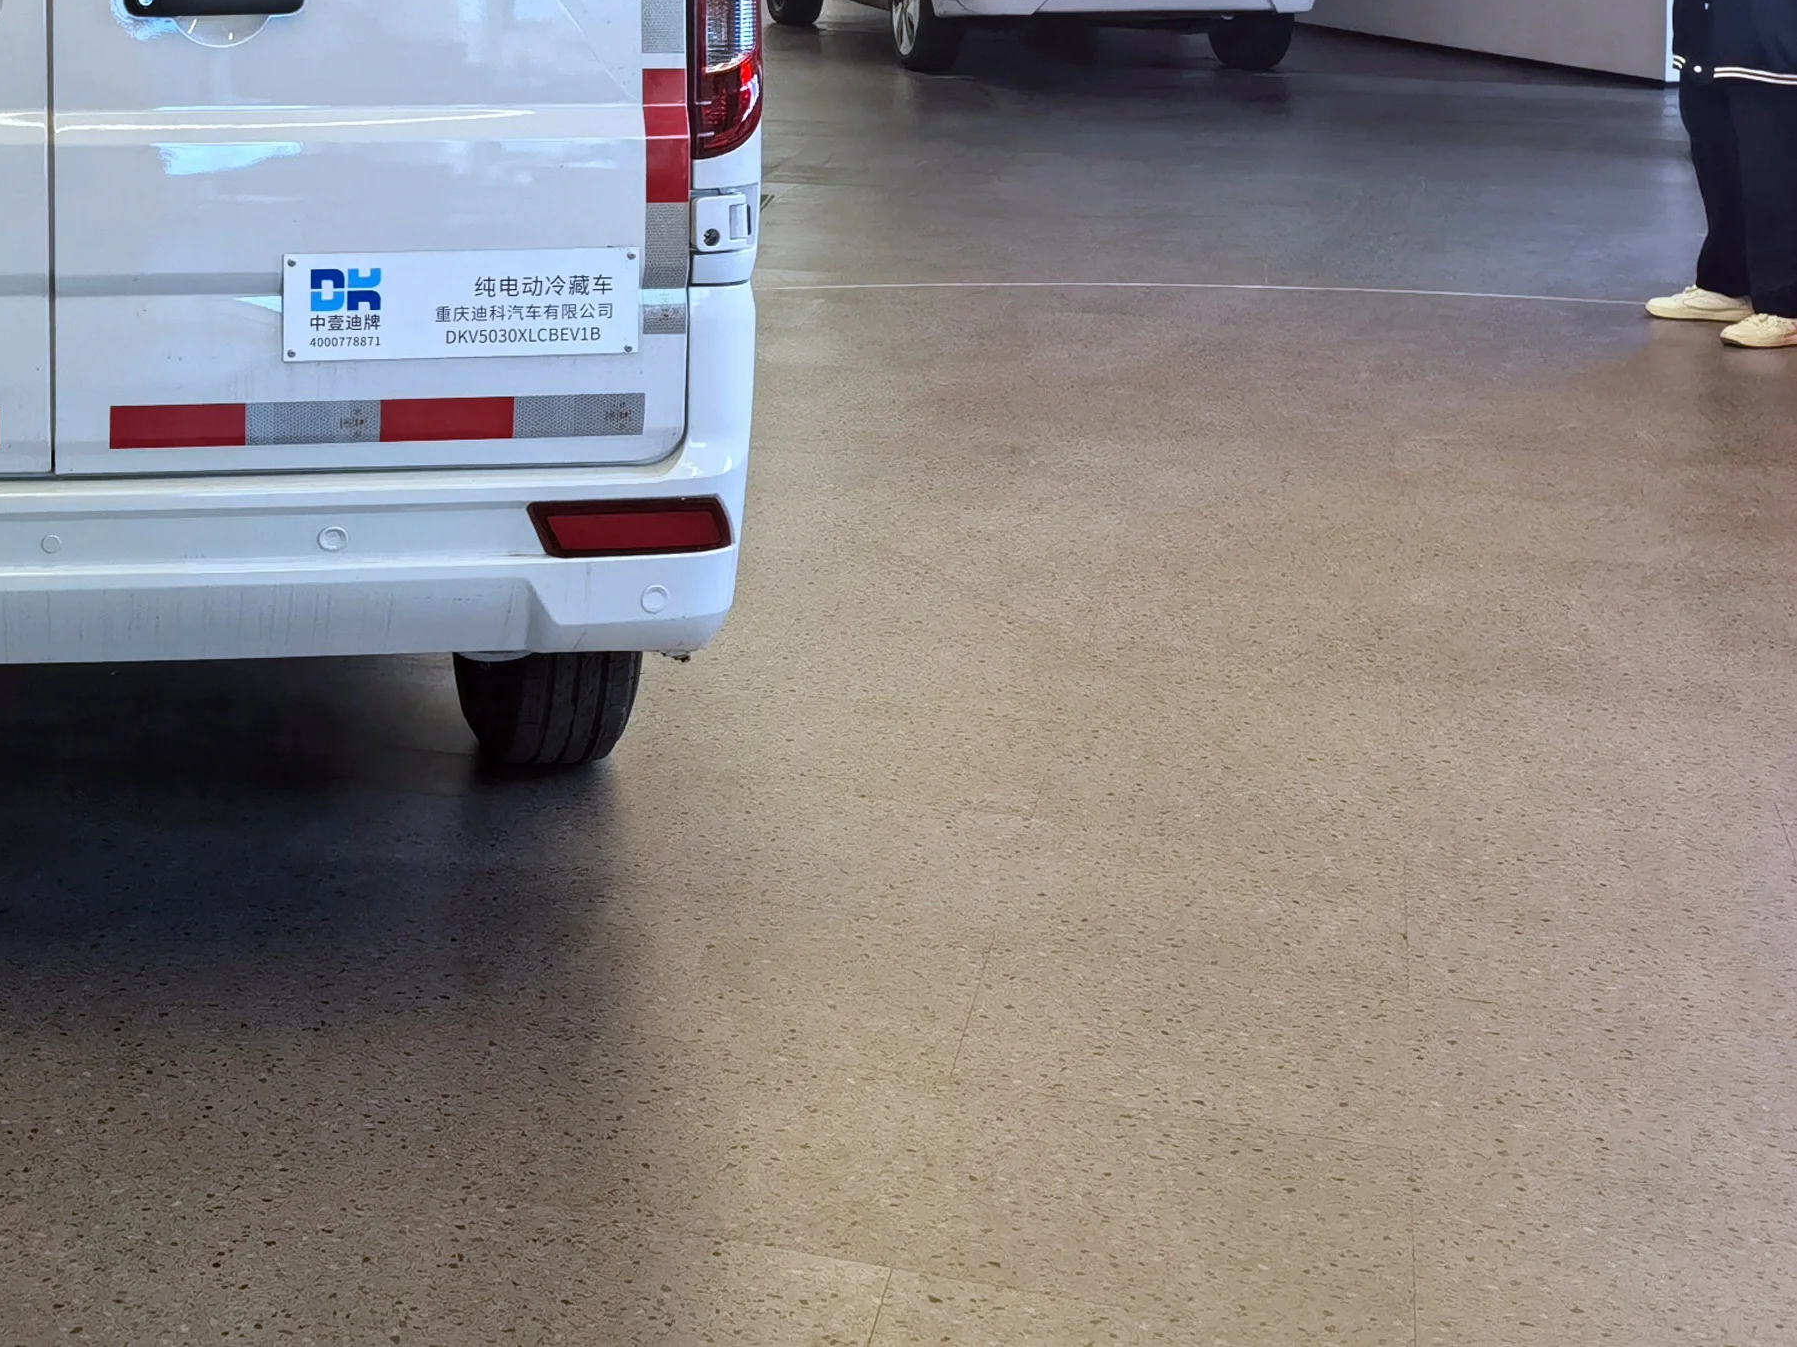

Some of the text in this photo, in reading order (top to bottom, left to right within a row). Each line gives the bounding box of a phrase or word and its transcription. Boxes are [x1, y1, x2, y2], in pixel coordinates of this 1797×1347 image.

[474, 274, 614, 298] 纯电动冷藏车
[309, 314, 381, 332] 中壹迪牌
[435, 303, 614, 324] 重庆迪科汽车有限公司
[309, 335, 381, 349] 4000778871
[445, 326, 602, 345] DKV5030XLCBEV1B
